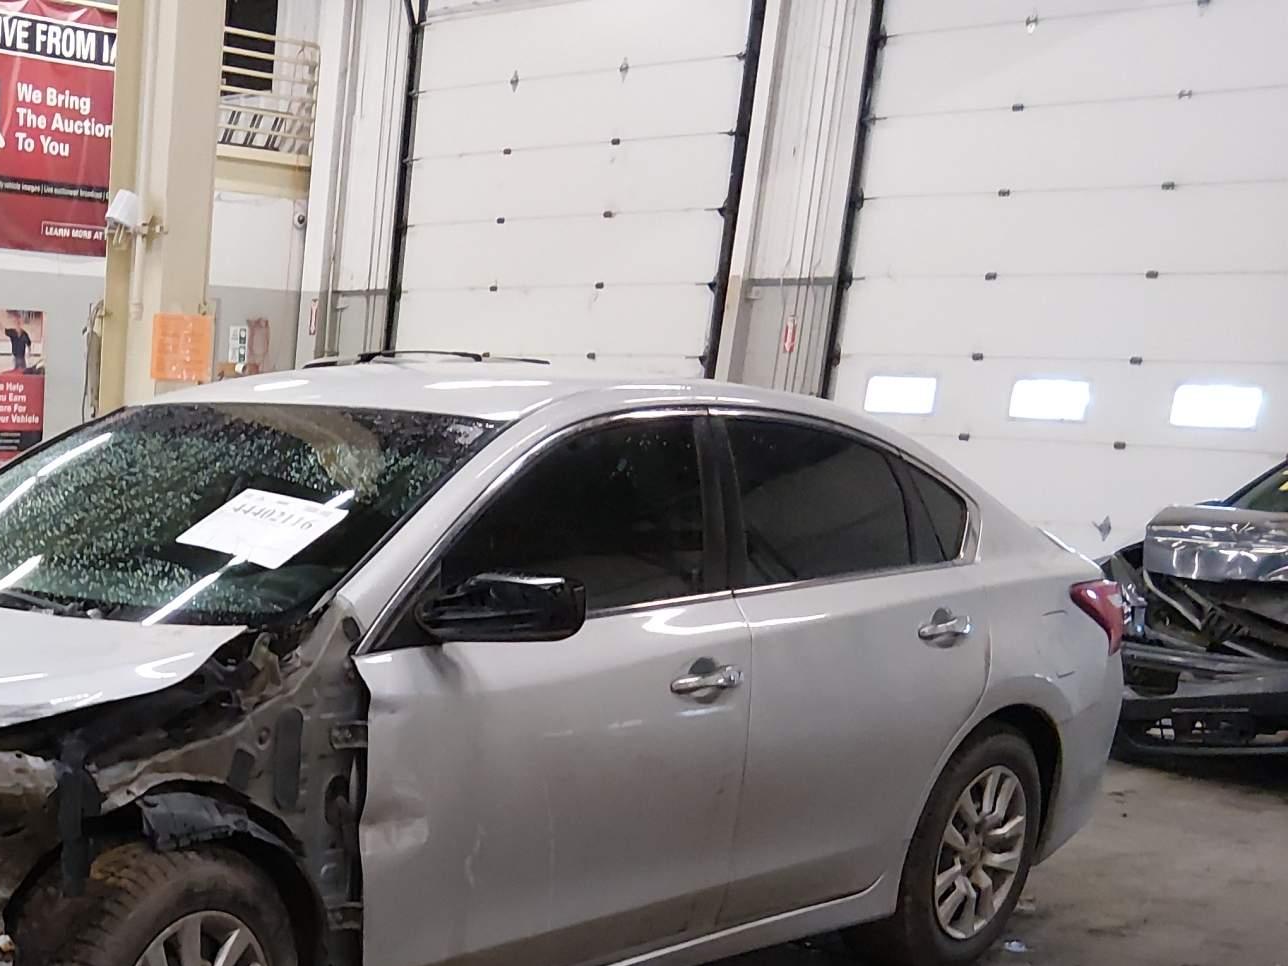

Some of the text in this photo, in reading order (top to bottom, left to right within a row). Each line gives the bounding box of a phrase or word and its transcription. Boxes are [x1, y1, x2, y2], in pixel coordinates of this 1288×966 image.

[35, 23, 96, 60] FROM
[17, 82, 90, 115] We Bring
[16, 107, 113, 138] The Auction
[15, 132, 70, 157] To You
[45, 226, 70, 238] LEARN
[93, 231, 103, 241] AT
[6, 382, 24, 394] Help
[8, 392, 27, 403] Earn
[13, 404, 27, 413] For
[11, 414, 40, 424] Vehicle
